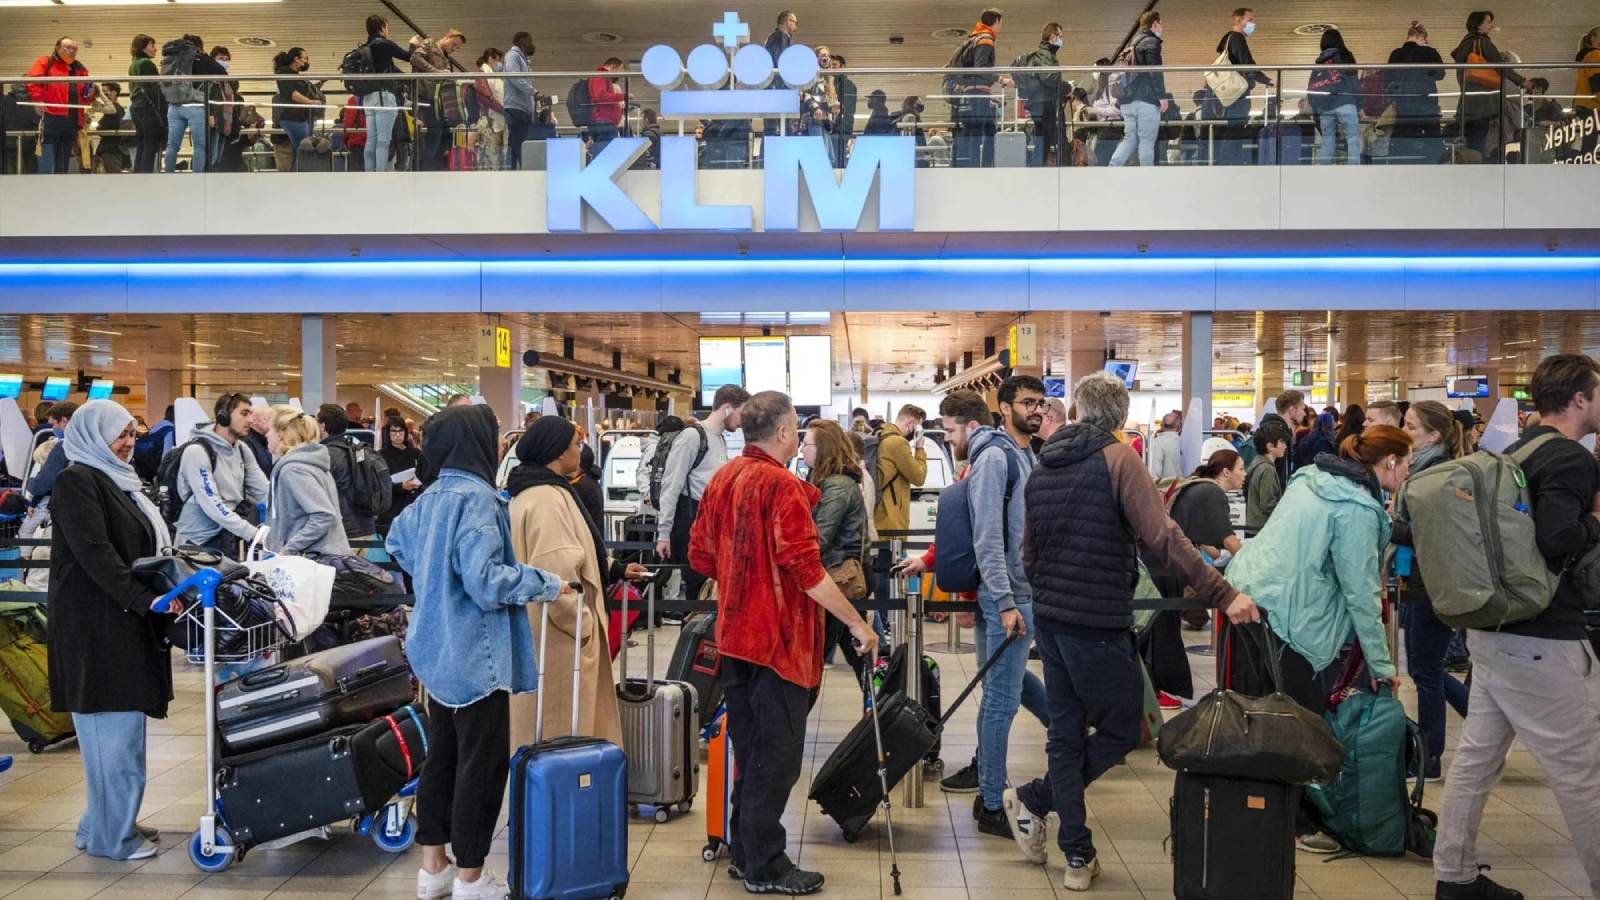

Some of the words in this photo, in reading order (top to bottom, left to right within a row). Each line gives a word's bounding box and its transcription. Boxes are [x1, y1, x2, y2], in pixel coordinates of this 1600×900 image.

[546, 136, 915, 232] KLM
[498, 329, 508, 355] 14
[1021, 327, 1031, 335] 13
